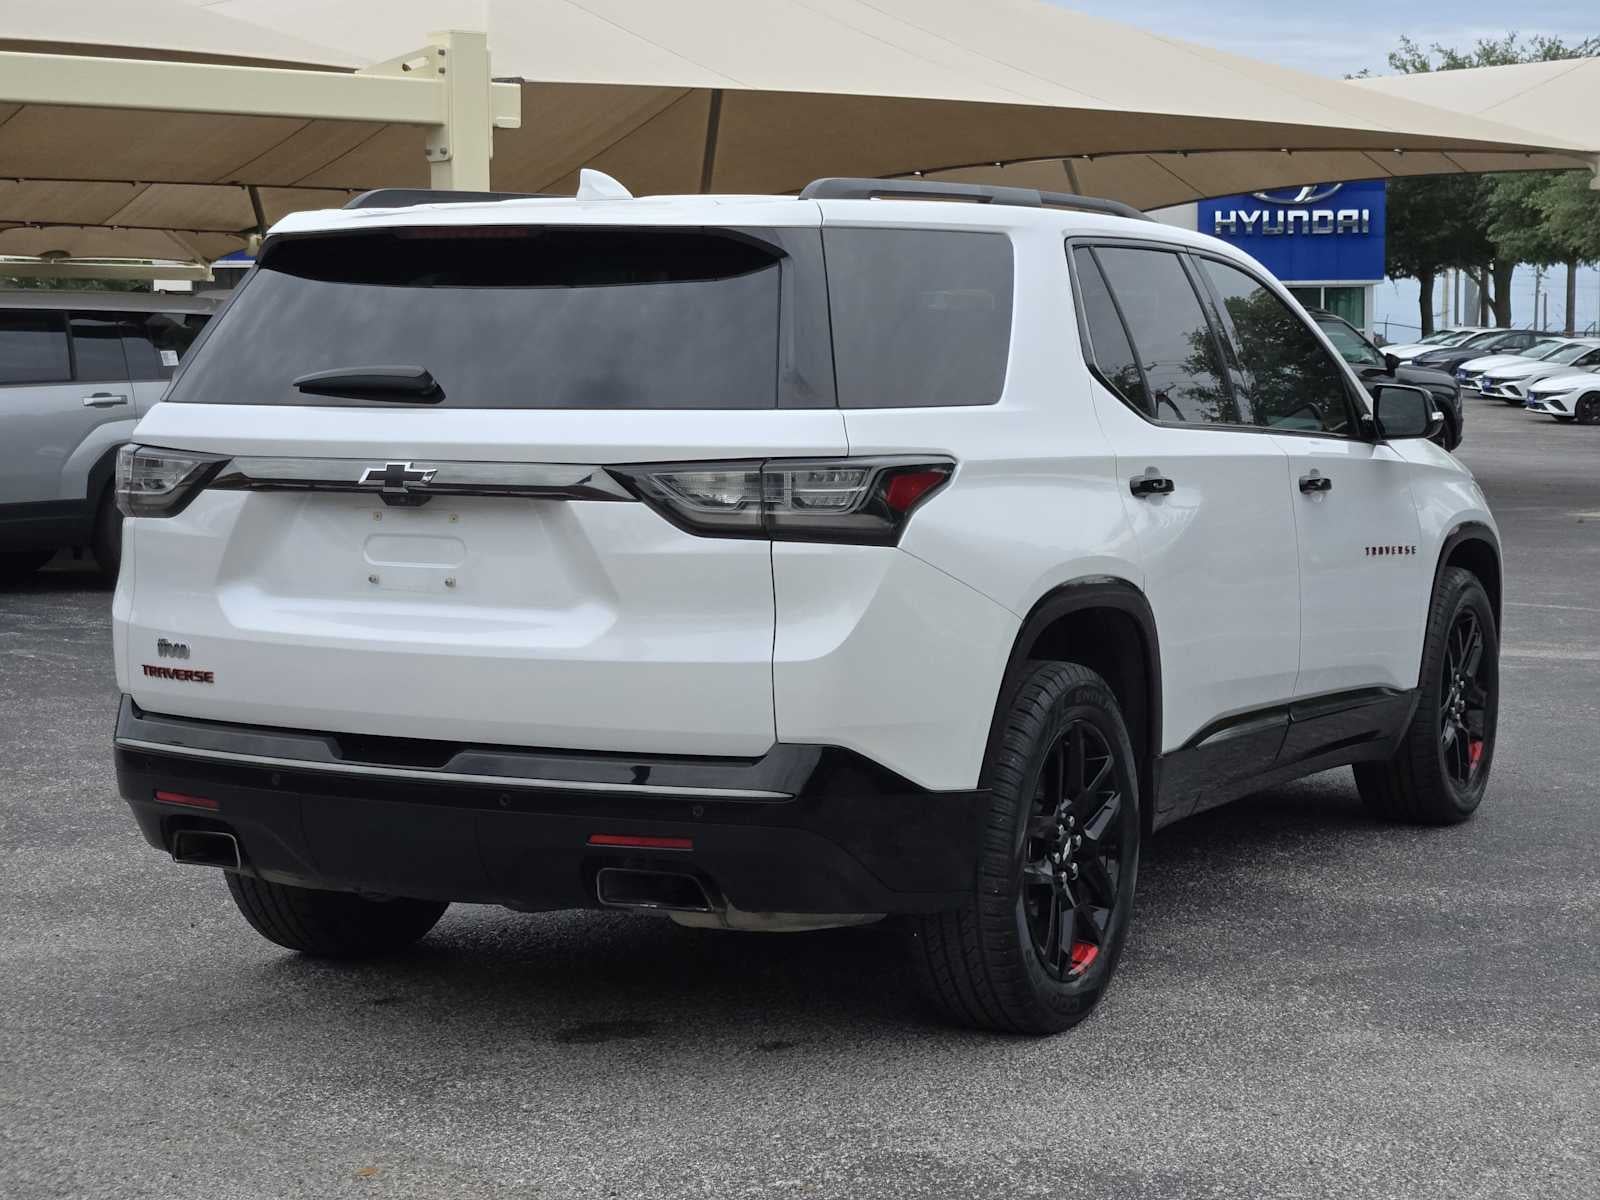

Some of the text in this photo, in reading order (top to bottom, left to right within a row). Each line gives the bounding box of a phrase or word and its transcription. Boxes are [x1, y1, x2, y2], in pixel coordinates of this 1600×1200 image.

[1214, 208, 1369, 235] HYUNDAI
[1365, 545, 1416, 556] TRAVERSE
[142, 664, 214, 683] TRAVERSE
